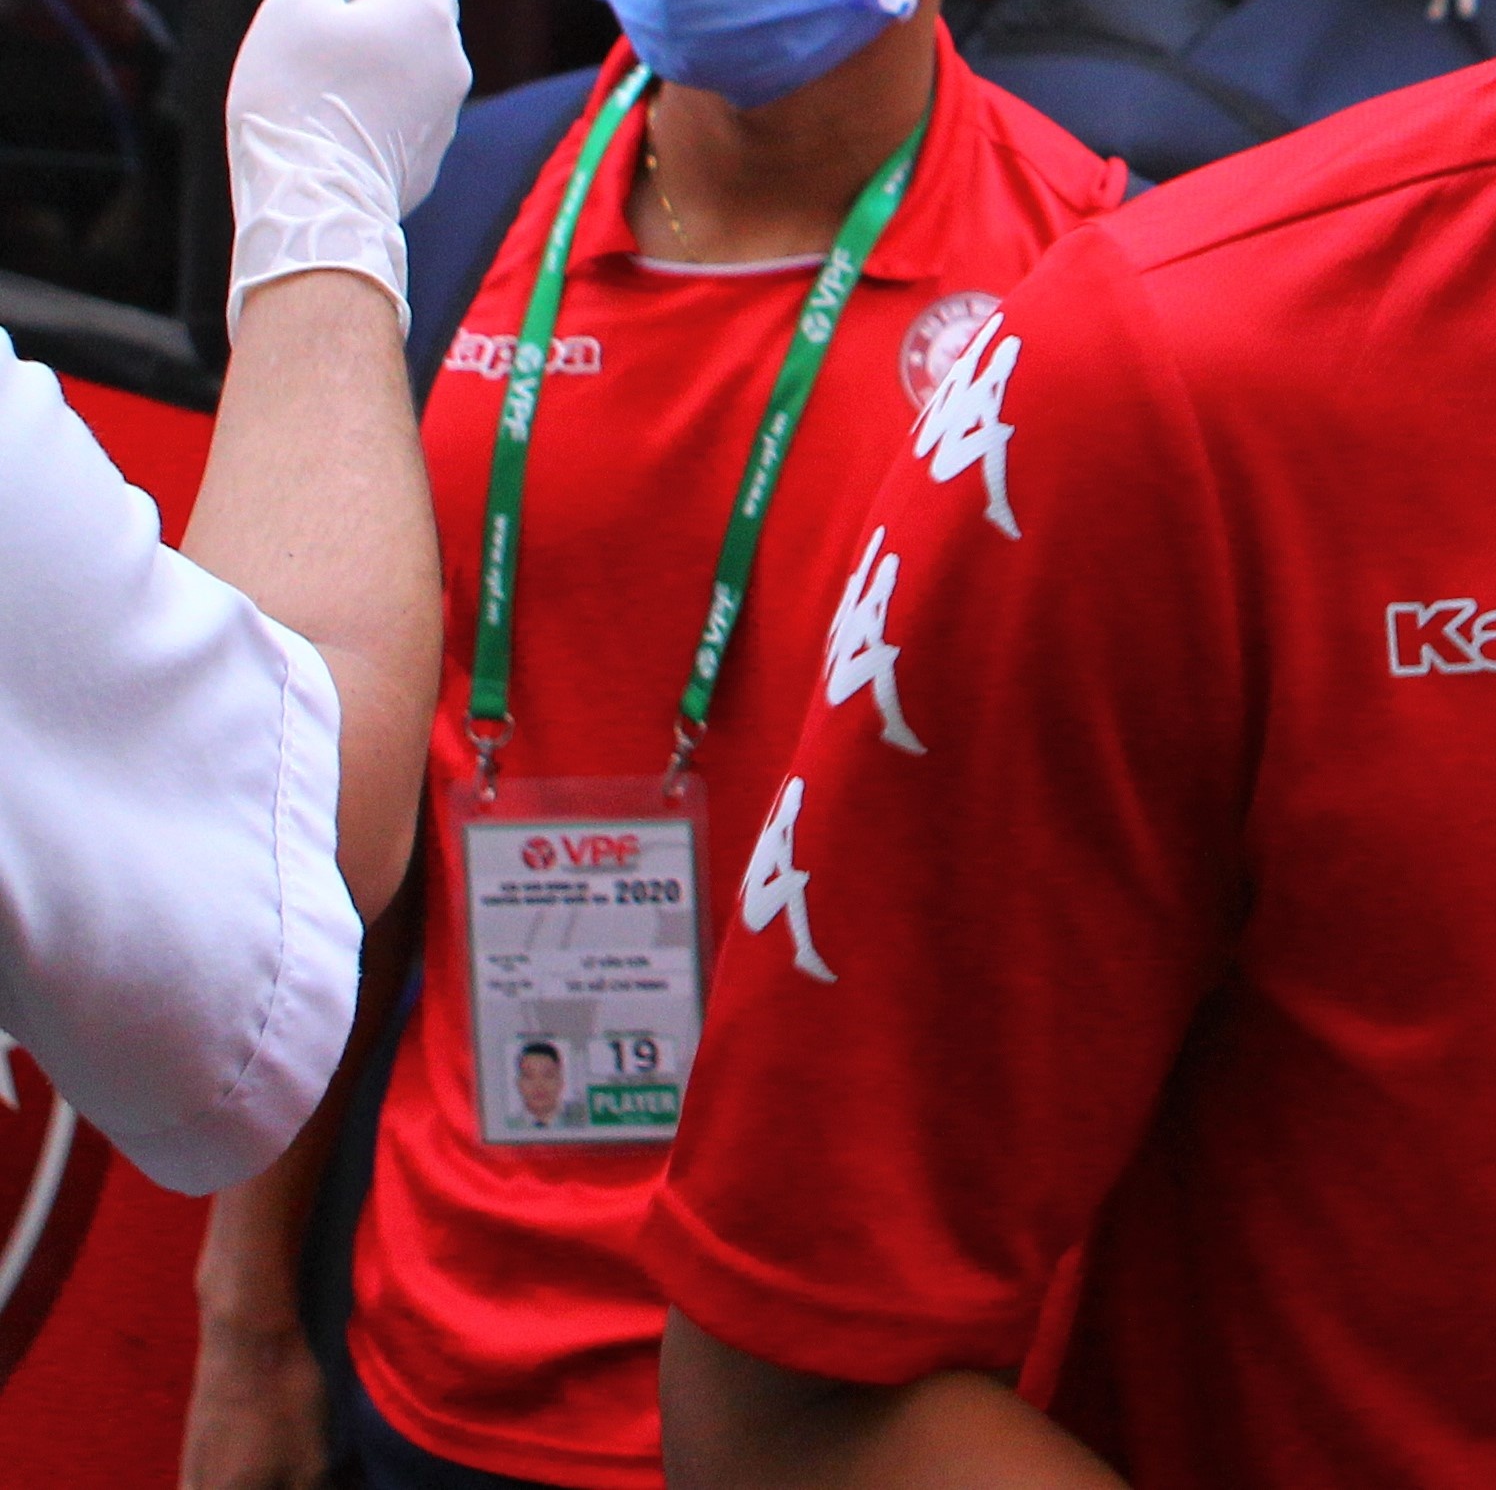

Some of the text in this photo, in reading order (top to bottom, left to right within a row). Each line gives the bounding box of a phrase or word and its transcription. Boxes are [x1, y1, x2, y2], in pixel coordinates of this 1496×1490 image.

[560, 833, 641, 867] VPF
[614, 877, 682, 905] 2020
[609, 1038, 658, 1073] 19
[593, 1090, 676, 1115] PLAYER
